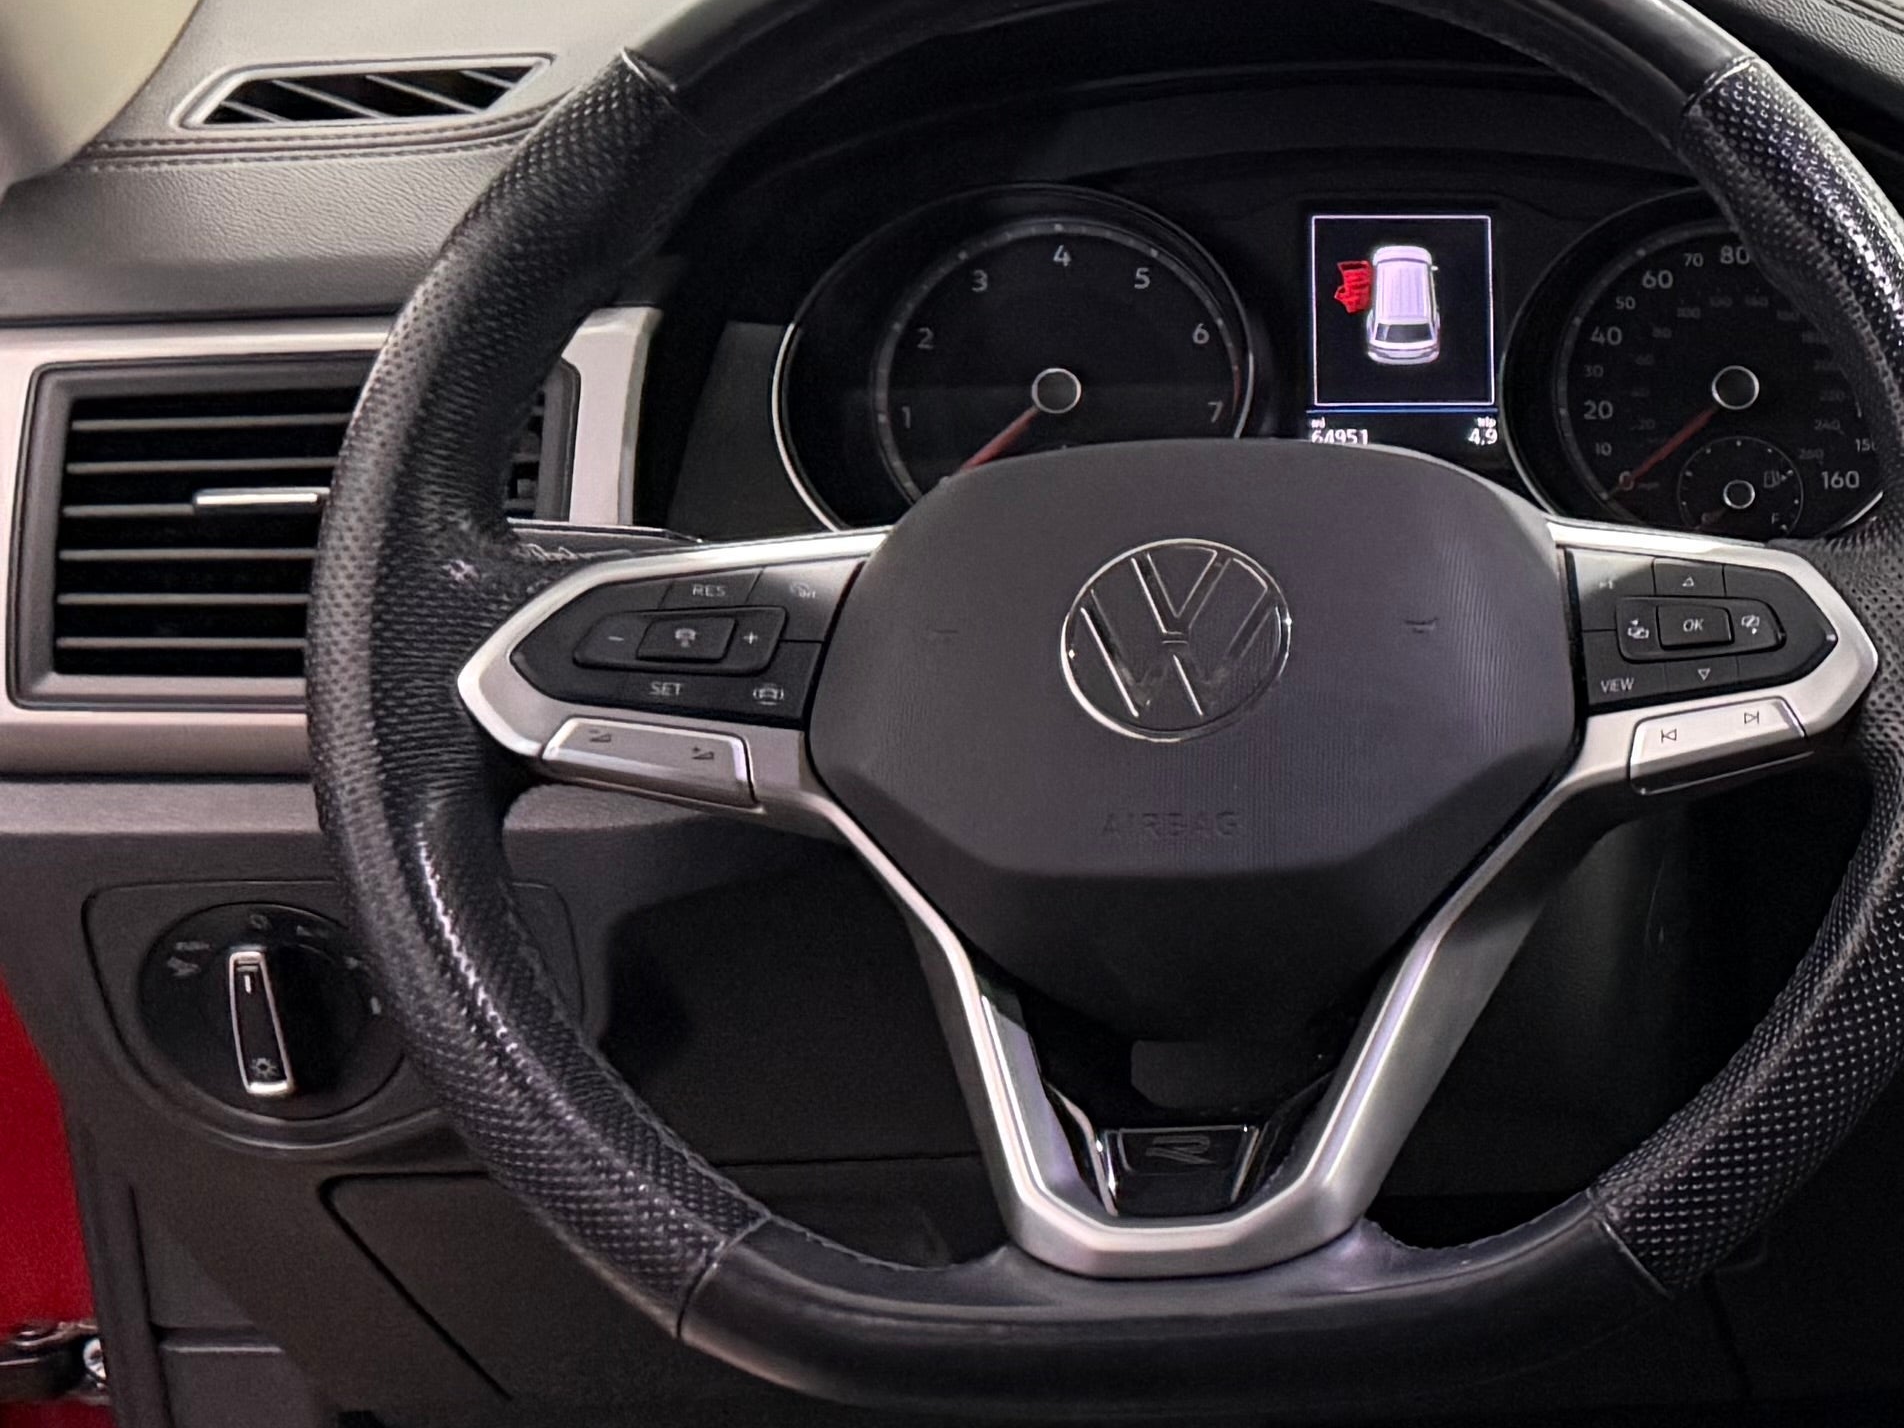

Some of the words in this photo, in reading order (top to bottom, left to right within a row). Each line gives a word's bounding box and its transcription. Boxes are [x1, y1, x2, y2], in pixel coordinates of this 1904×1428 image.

[1053, 244, 1071, 267] 4
[1684, 252, 1704, 268] 70
[1720, 245, 1750, 265] 80
[971, 270, 988, 292] 3
[1134, 267, 1150, 290] 5
[1642, 269, 1673, 289] 60
[1615, 296, 1636, 310] 50
[917, 327, 934, 350] 2
[1192, 322, 1210, 345] 6
[1590, 326, 1623, 346] 40
[1584, 364, 1604, 378] 30
[900, 405, 911, 428] 1
[1208, 400, 1224, 423] 7
[1583, 400, 1614, 420] 20
[1312, 429, 1368, 445] 64951
[1595, 442, 1612, 456] 10
[1821, 470, 1860, 490] 160
[692, 583, 726, 597] RES
[1682, 619, 1704, 632] OK
[649, 681, 682, 696] SET
[1600, 679, 1634, 693] VIEW
